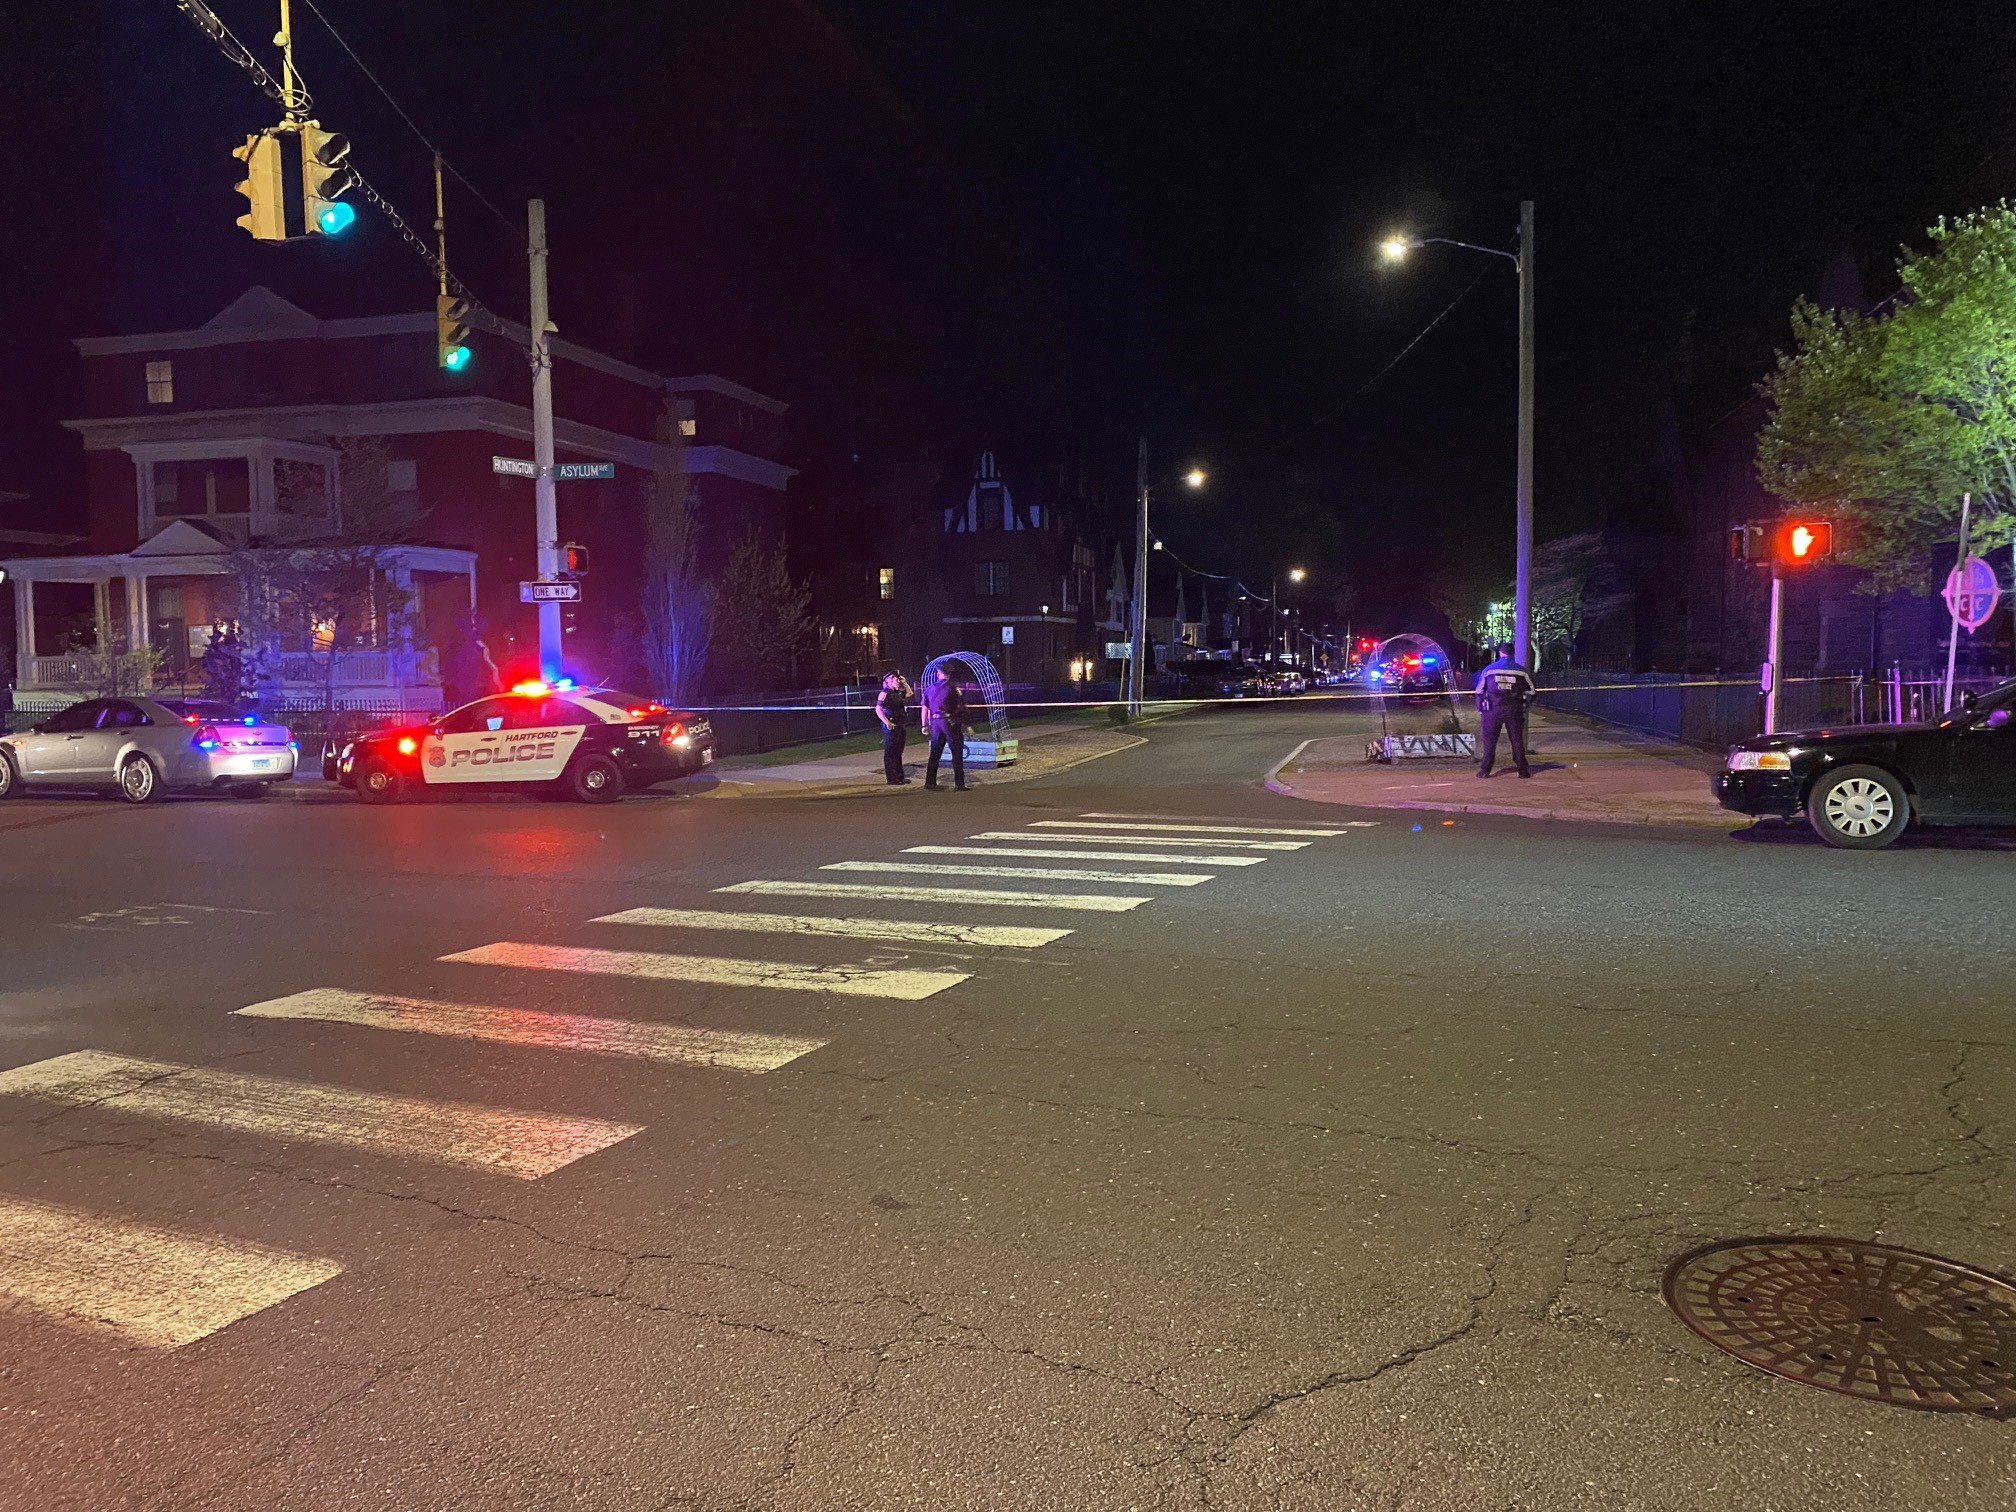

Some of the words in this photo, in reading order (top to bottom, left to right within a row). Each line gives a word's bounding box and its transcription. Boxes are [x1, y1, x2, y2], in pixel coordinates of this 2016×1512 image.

[494, 459, 534, 475] HUNTINGTON
[560, 465, 599, 477] ASYLUM
[599, 464, 609, 472] AVE
[535, 587, 549, 597] ONE
[554, 587, 569, 596] WAY
[505, 731, 559, 742] HARTFORD
[627, 730, 660, 738] 911
[451, 742, 555, 767] POLICE
